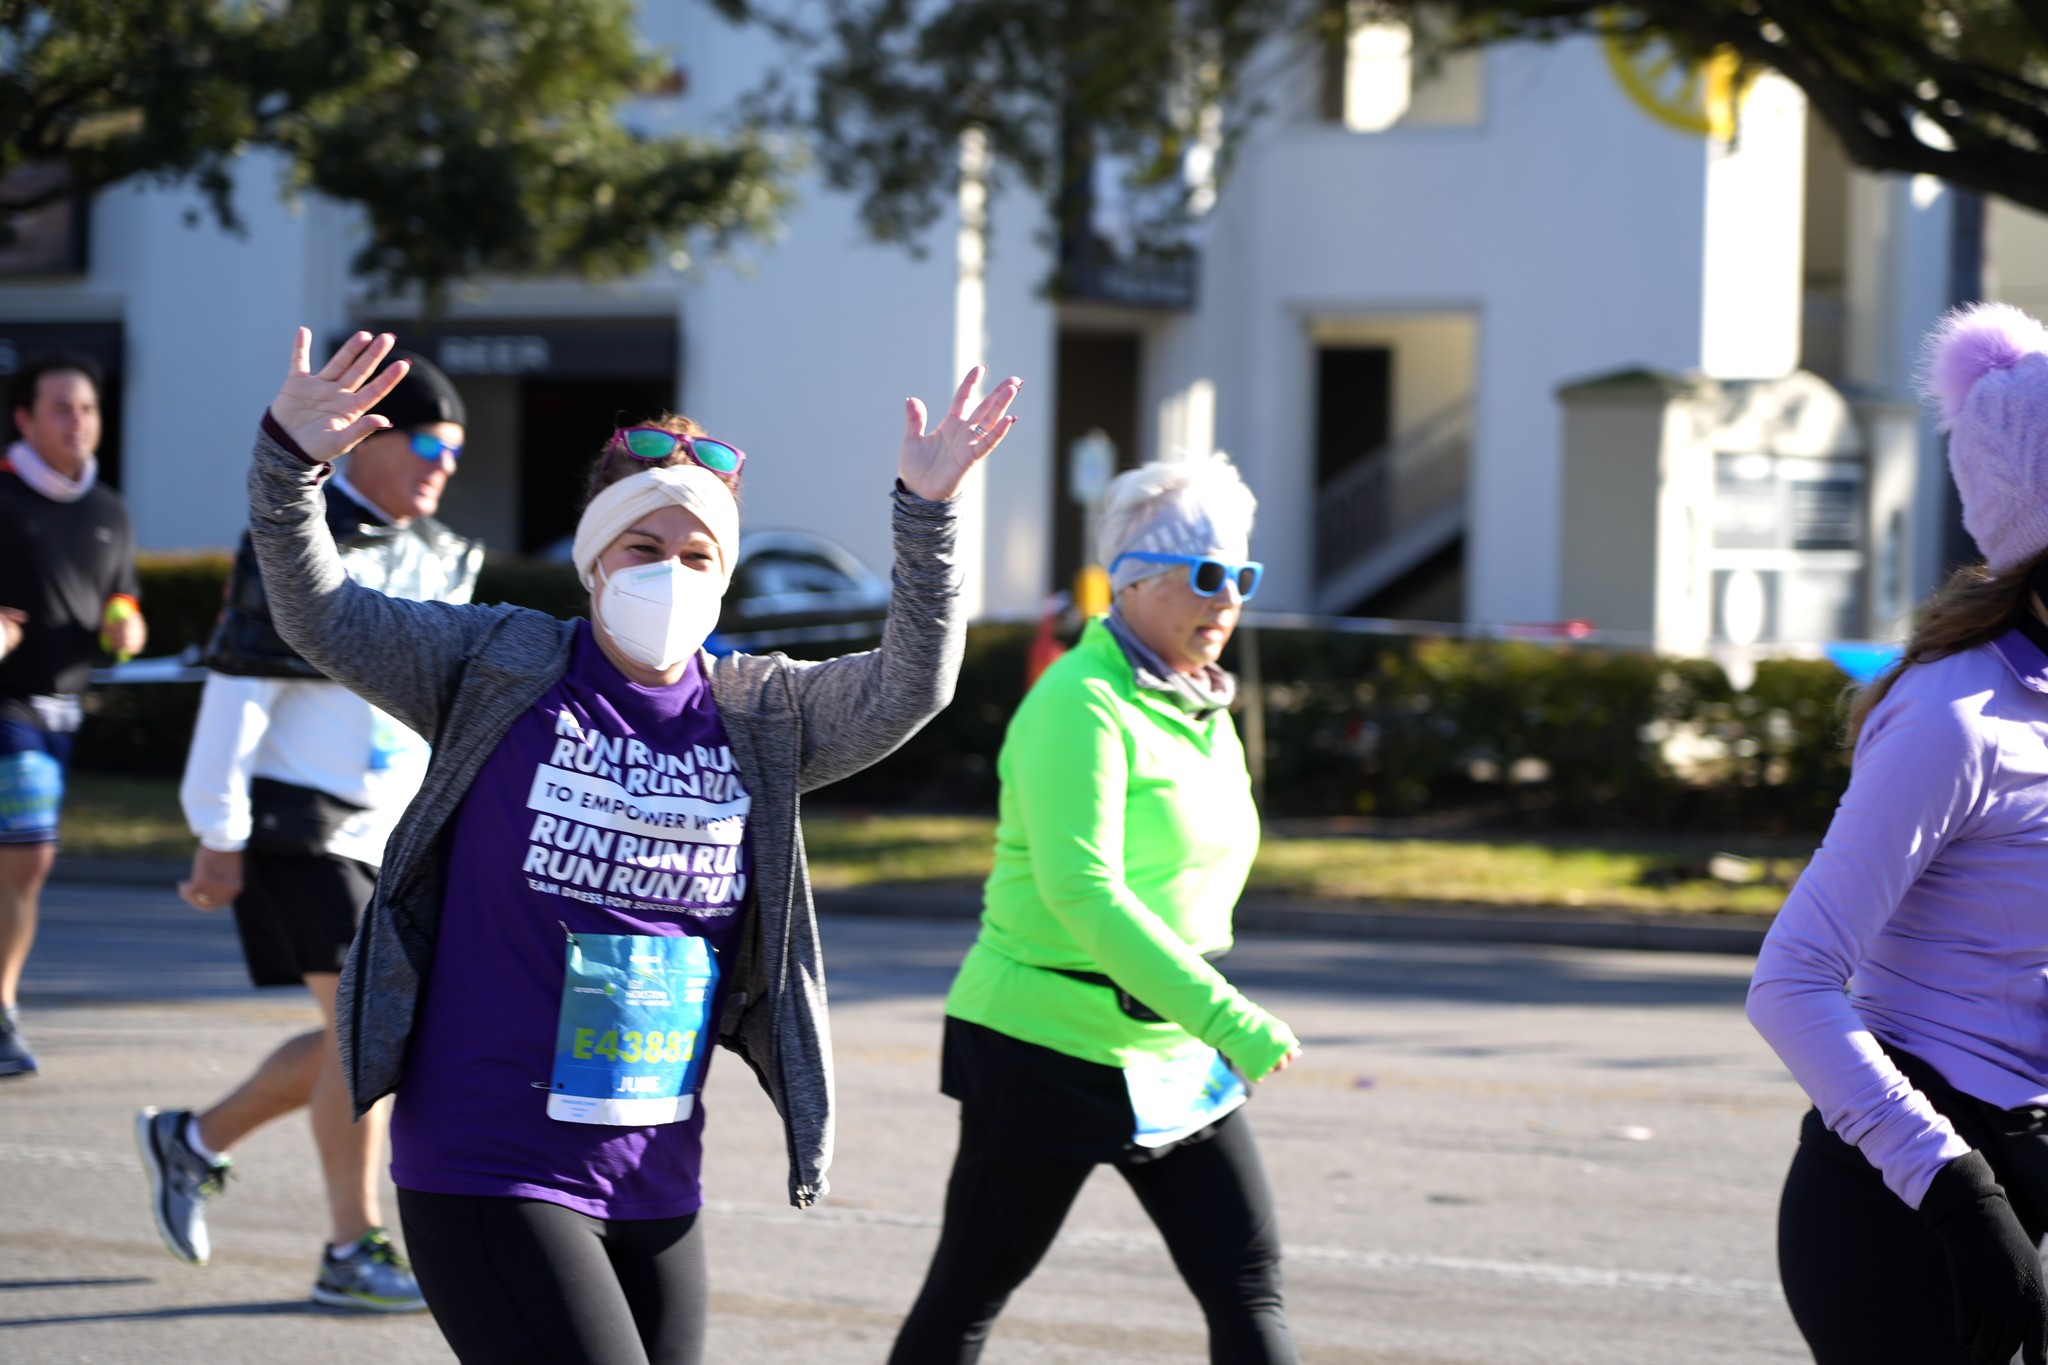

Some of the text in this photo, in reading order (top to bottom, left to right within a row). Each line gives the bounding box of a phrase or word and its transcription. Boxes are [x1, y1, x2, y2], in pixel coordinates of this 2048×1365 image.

[549, 738, 622, 786] RUN
[626, 767, 701, 796] RUN
[555, 710, 741, 776] RUN RUN RU
[545, 781, 573, 802] TO
[580, 791, 687, 829] EMPOWER
[529, 814, 616, 859] RUN
[614, 831, 692, 872] RUN
[522, 845, 748, 904] RUN RUN RUN
[526, 877, 560, 896] EAM
[560, 885, 604, 905] DRESS
[604, 895, 633, 910] FOR
[633, 900, 688, 915] SUCCESS
[616, 1075, 661, 1092] JUNE
